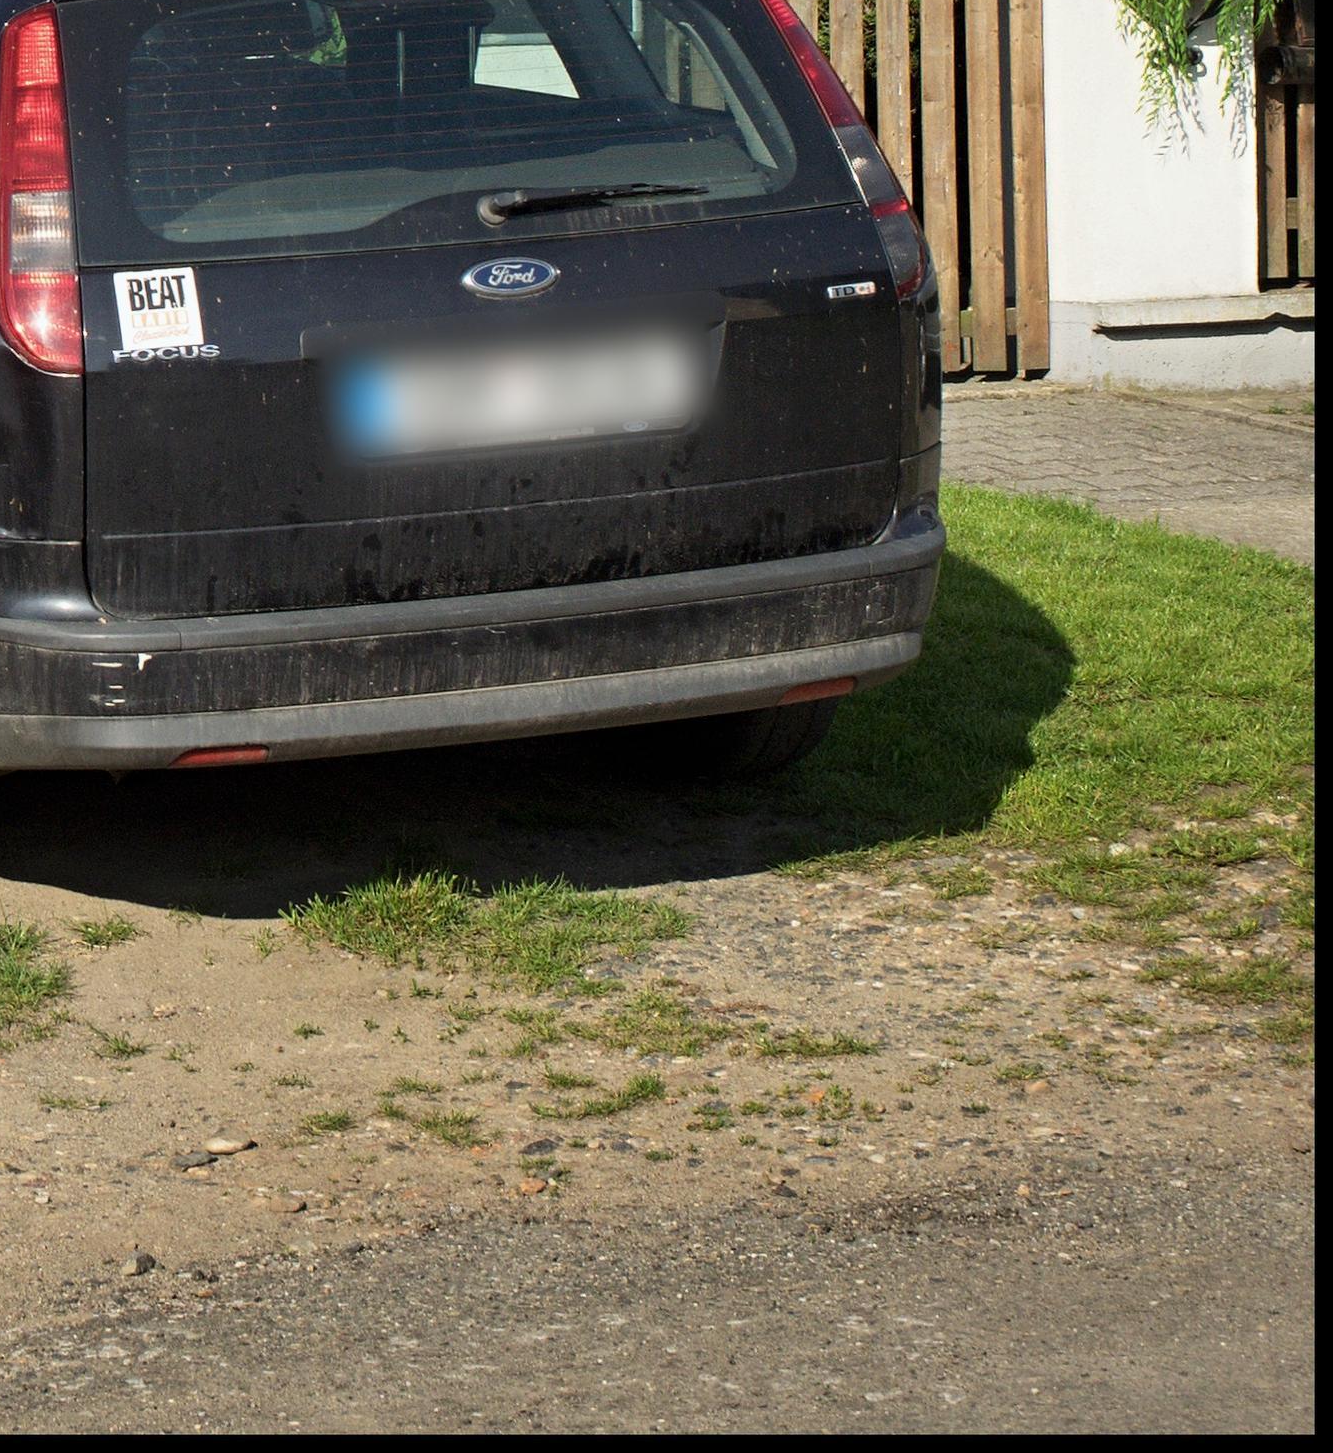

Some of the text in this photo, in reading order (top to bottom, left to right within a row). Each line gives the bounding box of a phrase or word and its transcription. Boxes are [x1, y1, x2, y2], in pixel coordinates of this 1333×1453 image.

[487, 263, 536, 288] Ford
[126, 274, 186, 312] BEAT
[112, 344, 221, 364] FOCUS
